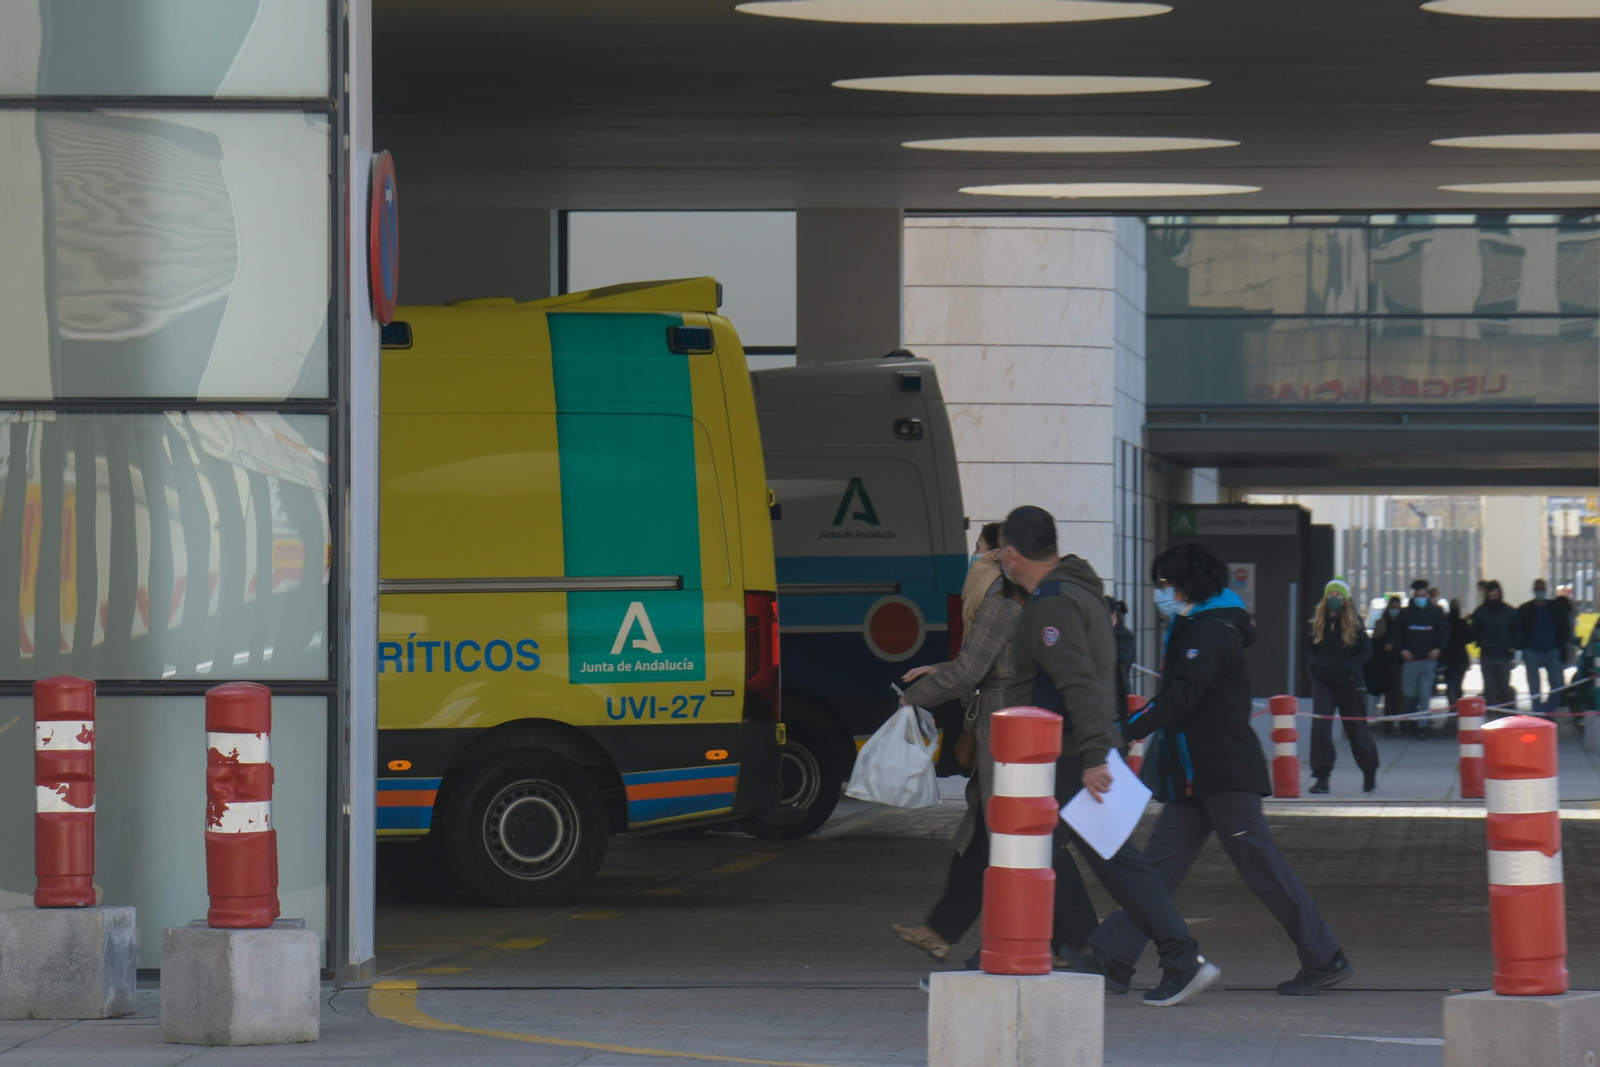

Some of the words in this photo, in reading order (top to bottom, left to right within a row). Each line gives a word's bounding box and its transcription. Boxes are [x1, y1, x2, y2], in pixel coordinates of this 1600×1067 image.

[819, 530, 841, 539] Junta
[843, 530, 854, 539] de
[855, 529, 896, 539] Andalucía
[378, 632, 541, 673] RÍTICOS
[580, 661, 615, 673] Junta
[617, 660, 632, 672] de
[634, 657, 694, 672] Andalucía
[606, 694, 706, 721] UVI-27
